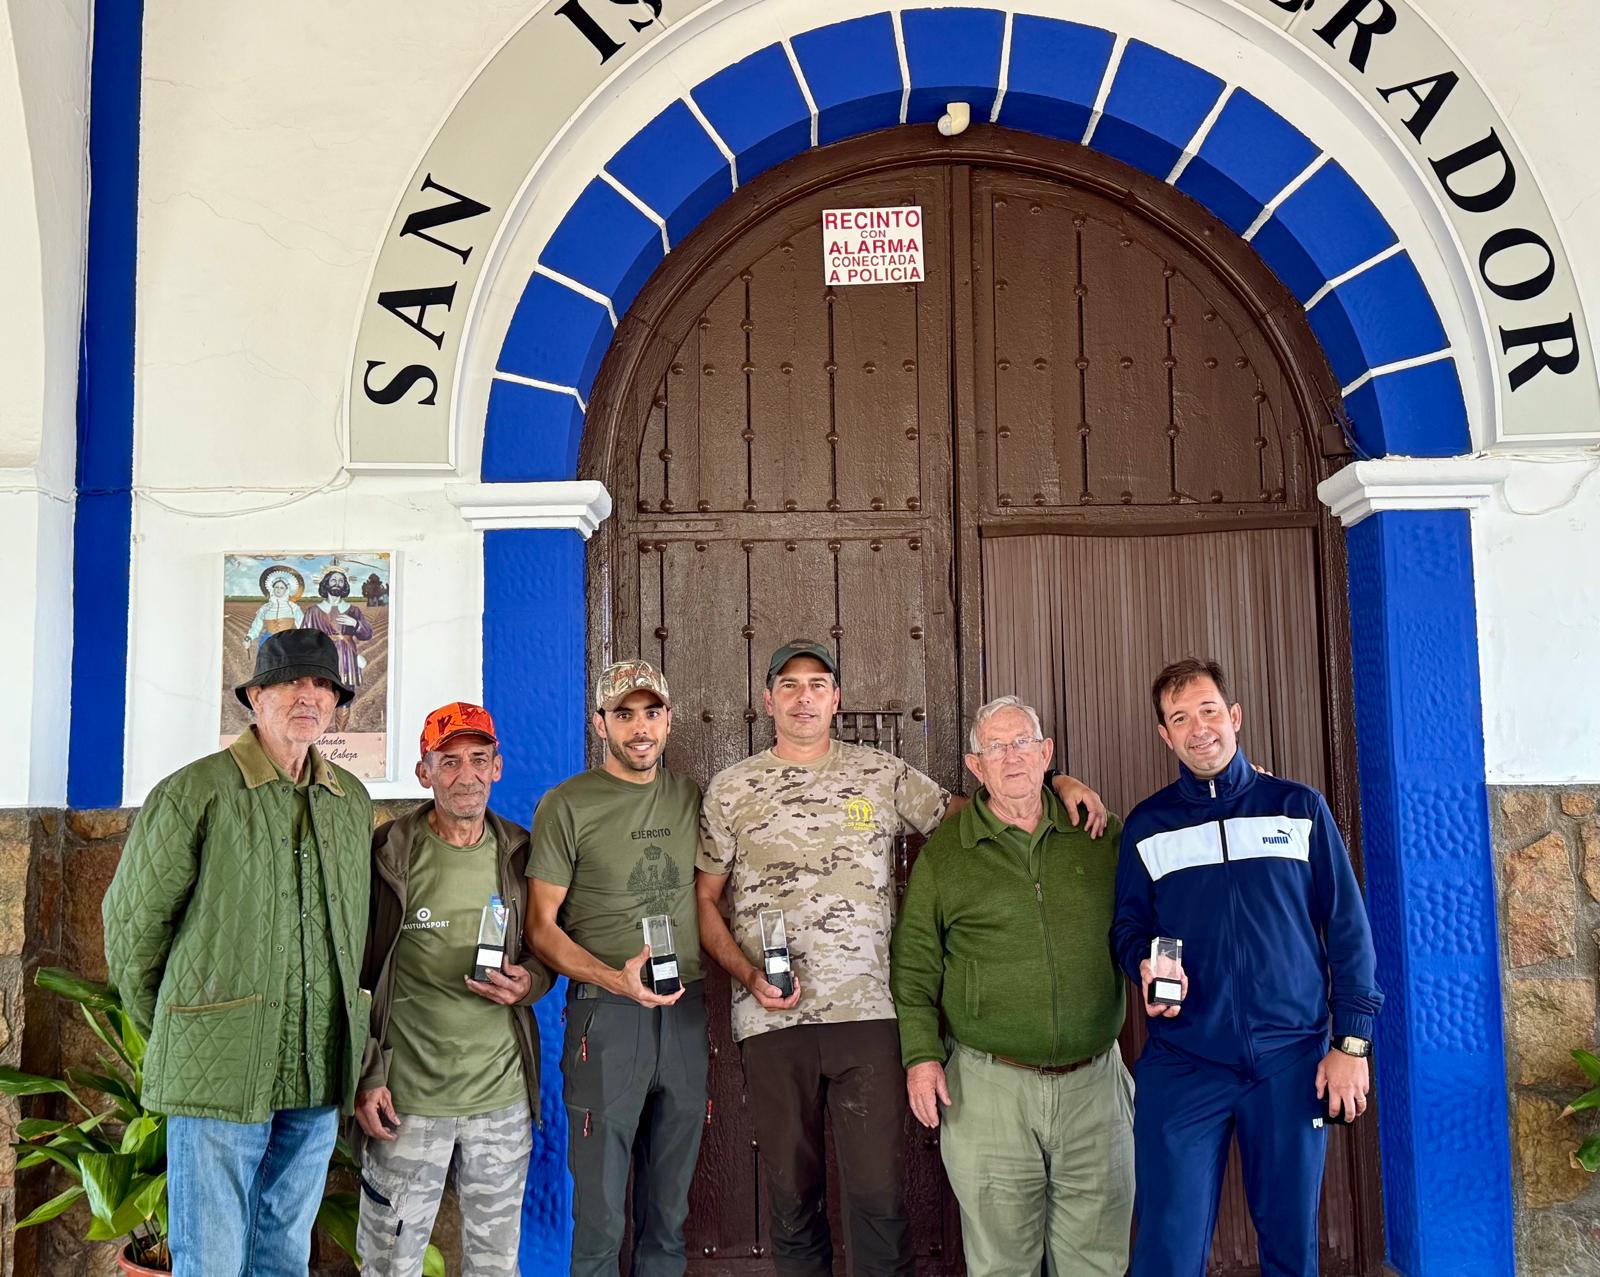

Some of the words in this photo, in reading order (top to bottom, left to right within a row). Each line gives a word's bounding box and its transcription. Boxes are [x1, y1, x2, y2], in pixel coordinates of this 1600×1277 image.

[363, 172, 491, 406] SAN
[1269, 0, 1580, 392] RADOR
[825, 210, 920, 230] RECINTO
[860, 229, 886, 239] CON
[828, 238, 919, 255] ALARMA
[832, 254, 916, 268] CONECTADA
[829, 270, 841, 283] A
[848, 267, 921, 282] POLICIA
[330, 748, 359, 761] Cabeza
[631, 828, 671, 840] EJERCITO
[1262, 836, 1289, 844] PUMA
